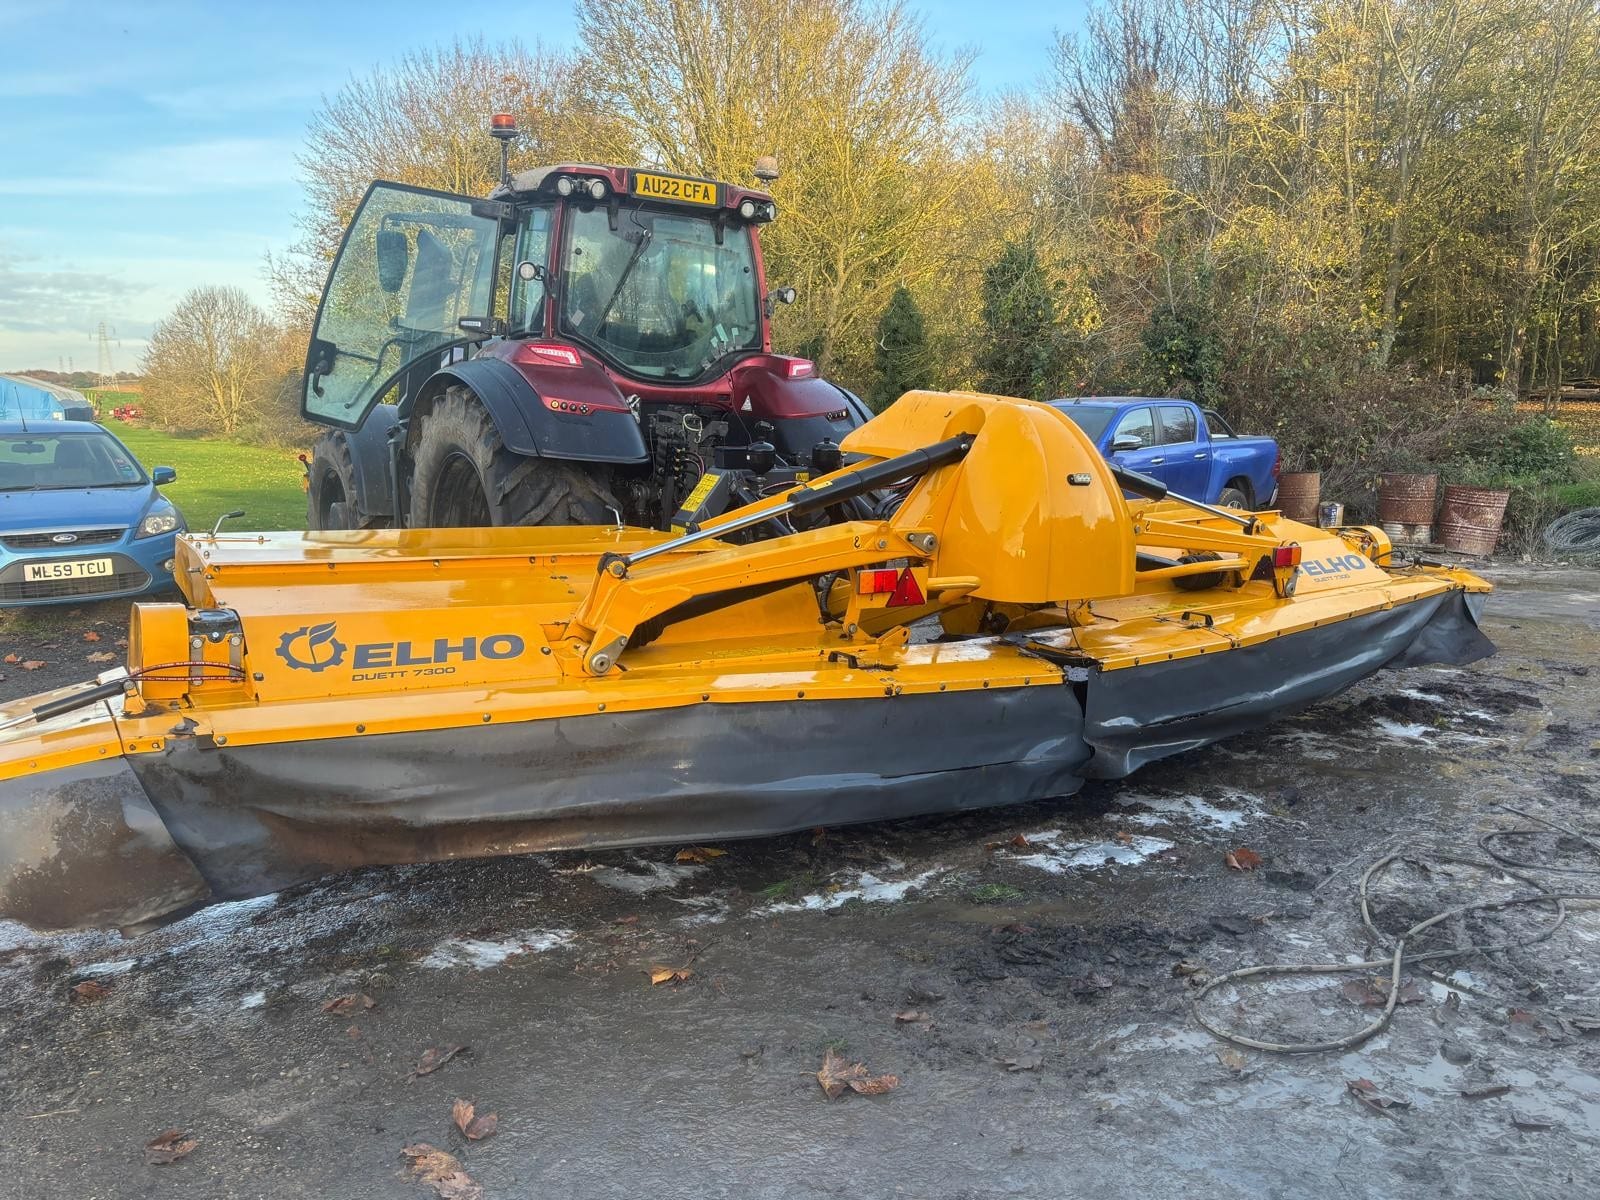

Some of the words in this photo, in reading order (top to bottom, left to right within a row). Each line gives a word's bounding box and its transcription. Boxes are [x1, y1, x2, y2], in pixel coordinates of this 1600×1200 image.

[643, 177, 680, 196] AU22
[683, 183, 710, 200] CFA
[32, 564, 72, 579] ML59
[77, 562, 106, 575] TCU
[1301, 554, 1366, 576] ELHO
[352, 634, 525, 670] ELHO
[352, 670, 408, 682] DUETT
[413, 666, 456, 677] 7300
